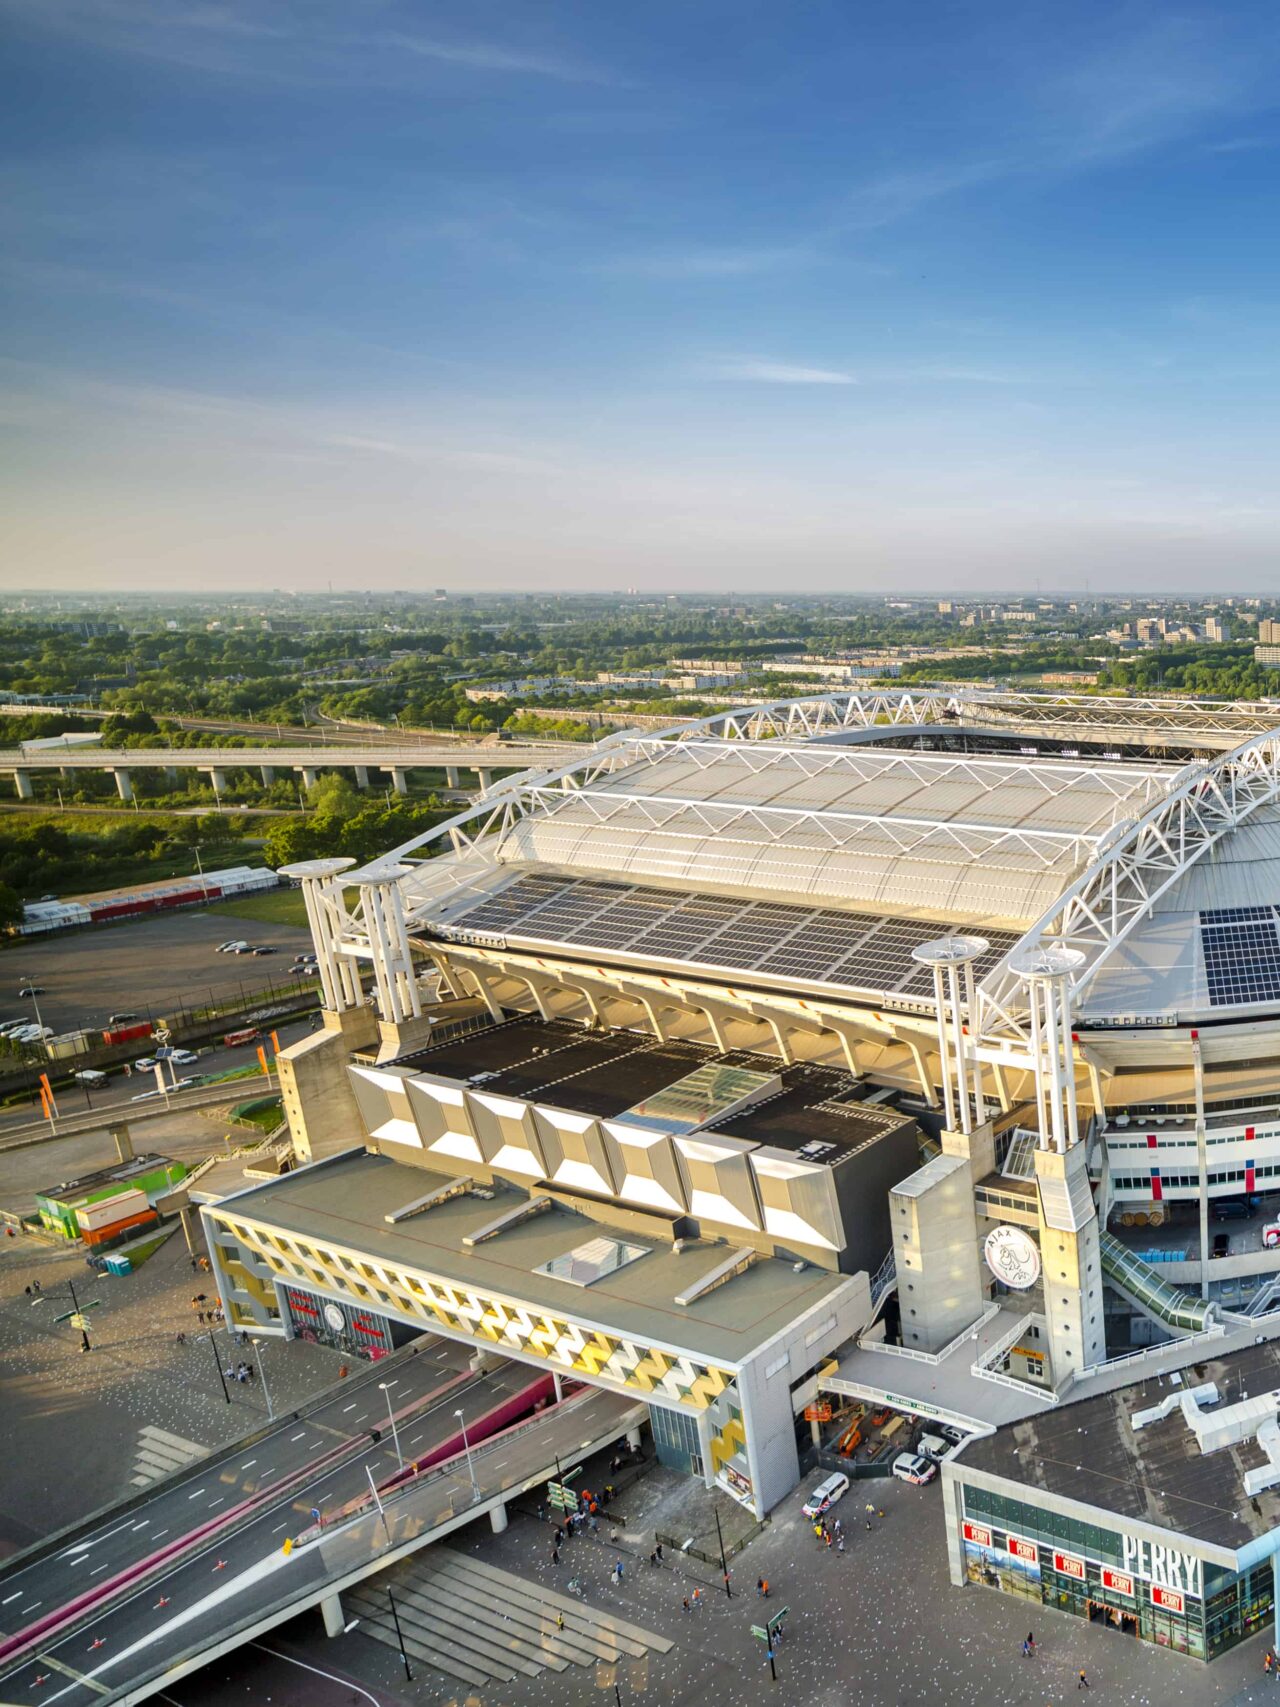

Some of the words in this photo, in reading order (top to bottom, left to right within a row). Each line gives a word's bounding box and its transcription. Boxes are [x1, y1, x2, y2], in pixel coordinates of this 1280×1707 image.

[988, 1230, 1011, 1248] AJAX
[972, 1527, 988, 1543] PERRY
[1017, 1542, 1034, 1558] PERRY
[1064, 1558, 1080, 1574] PERRY
[1122, 1533, 1198, 1592] PERRY
[1112, 1575, 1128, 1591] PERRY
[1162, 1593, 1179, 1608] PERRY
